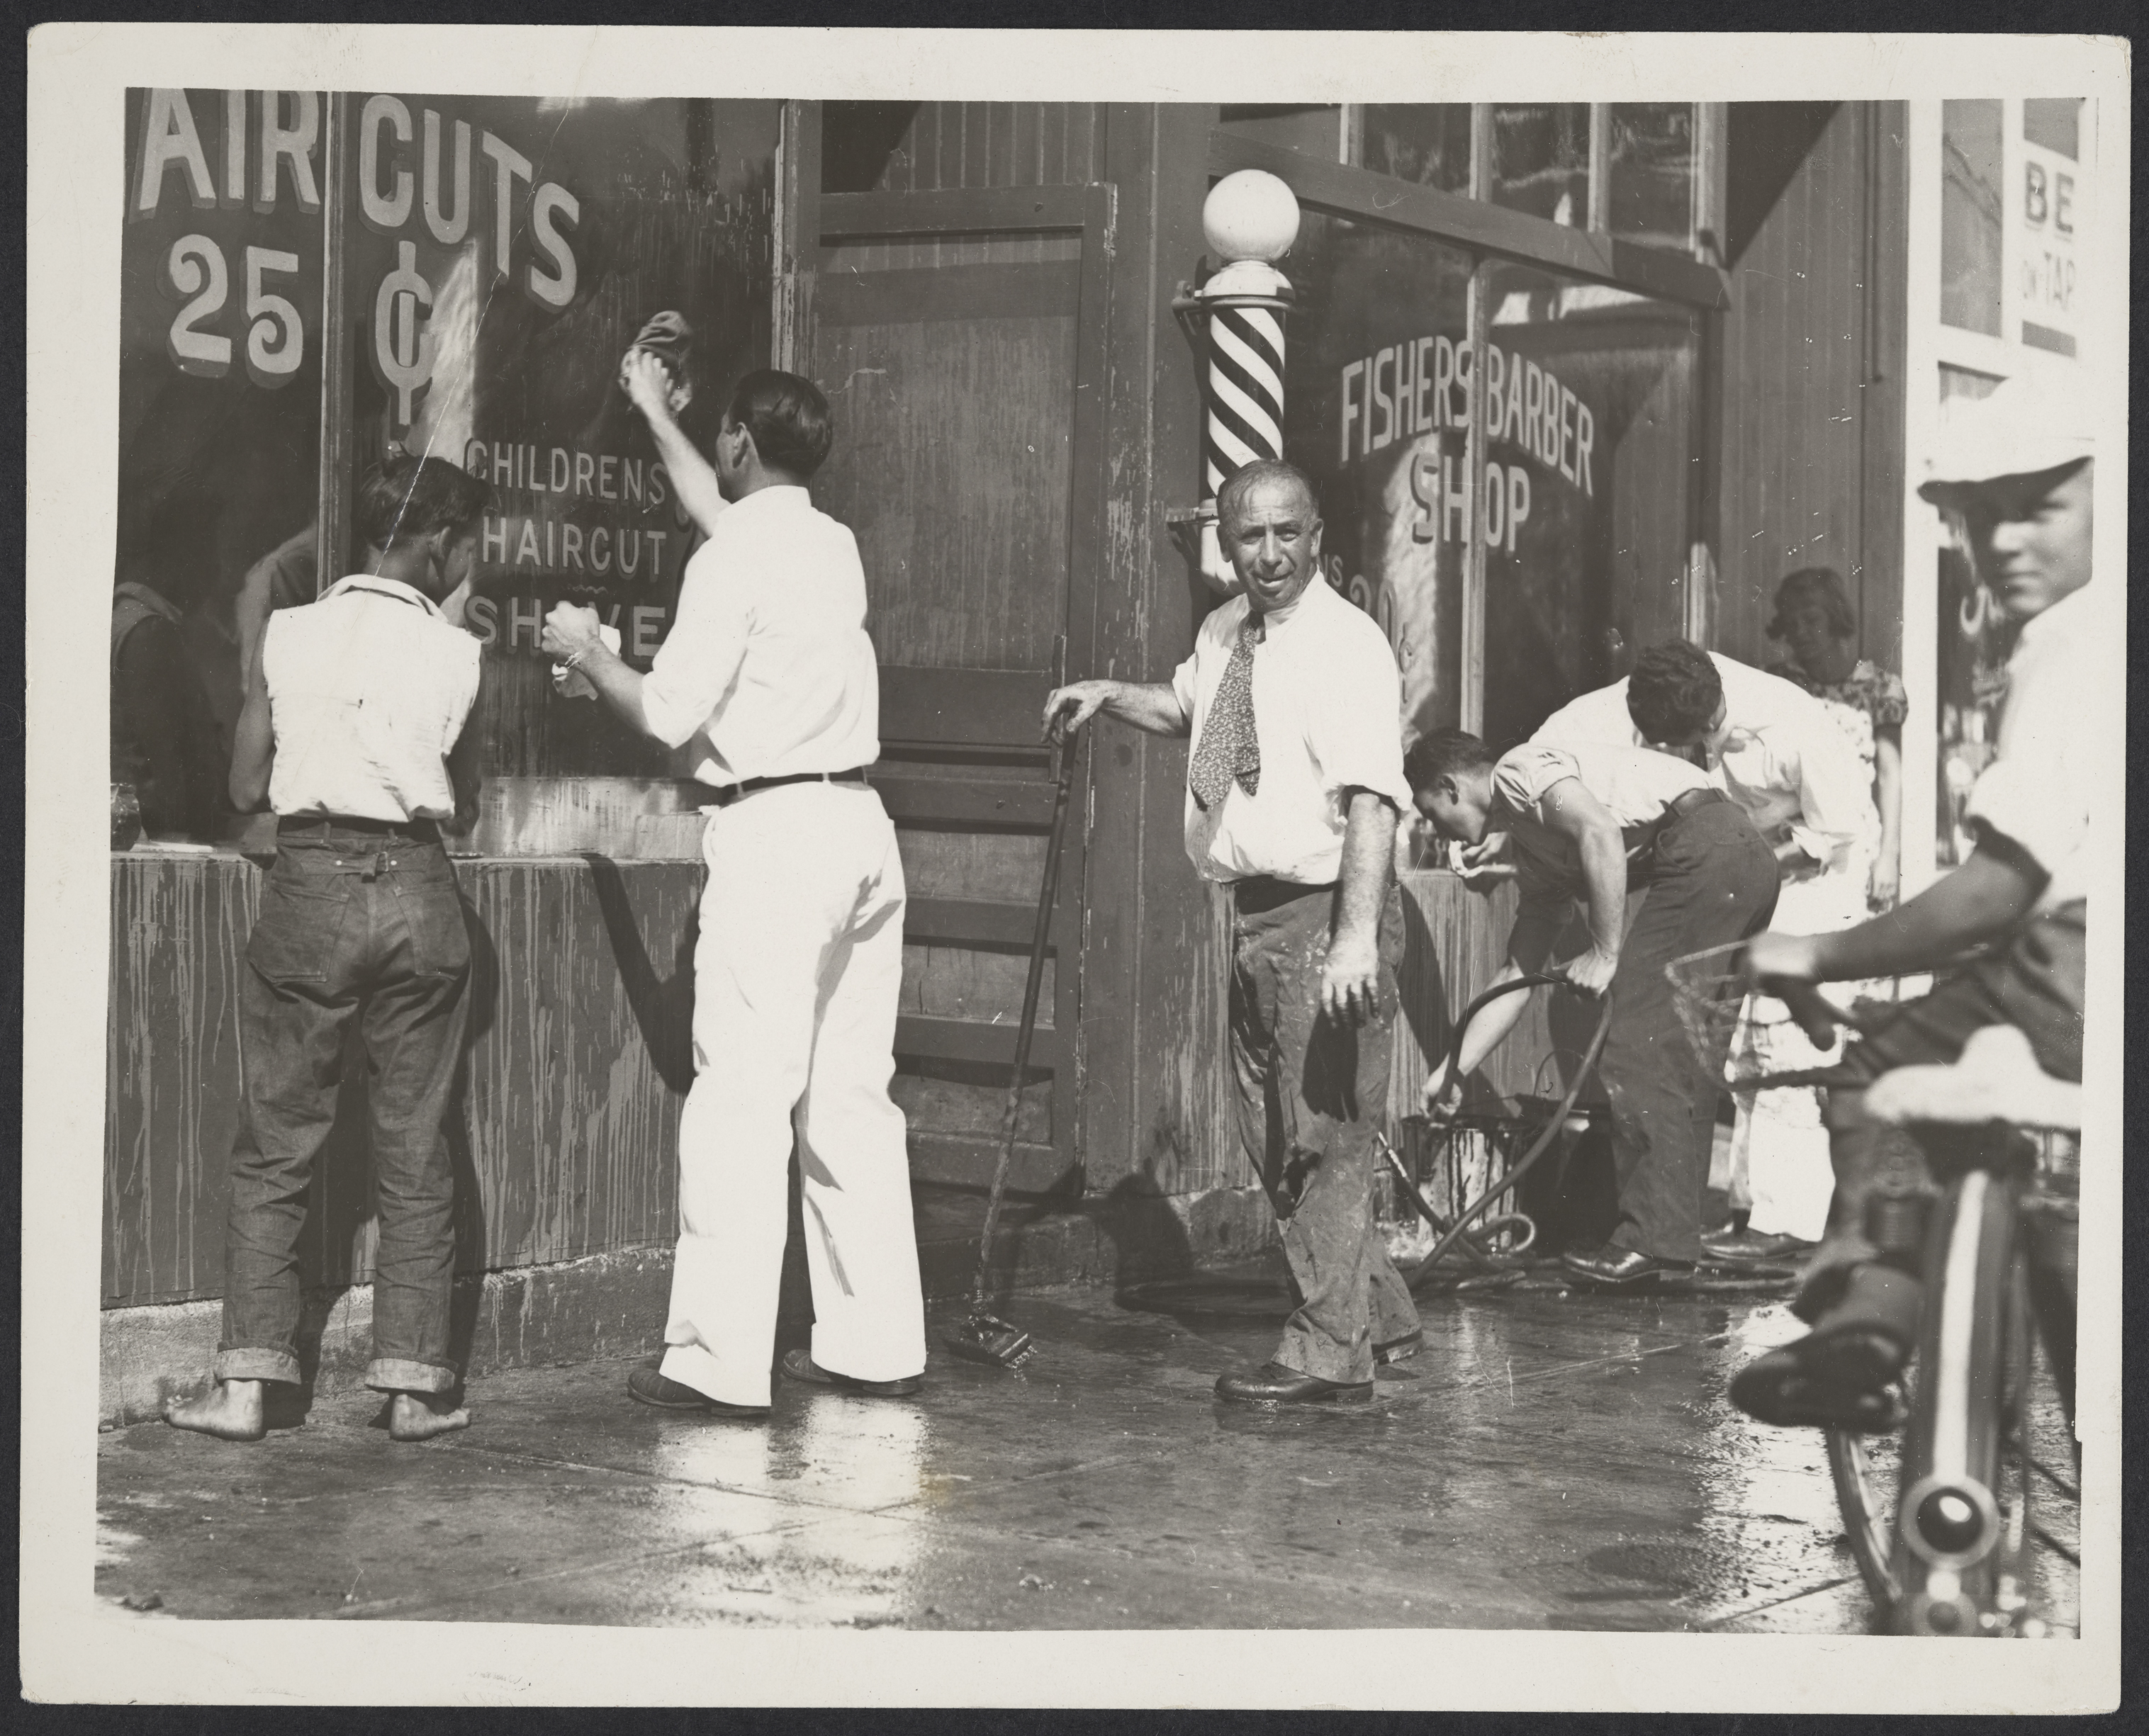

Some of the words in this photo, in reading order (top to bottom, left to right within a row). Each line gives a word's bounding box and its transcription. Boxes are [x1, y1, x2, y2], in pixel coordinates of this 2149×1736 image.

[359, 94, 580, 308] CUTS
[169, 234, 303, 376] 25
[1342, 335, 1474, 463] FISHERS
[1486, 342, 1594, 497] BARBER
[466, 440, 668, 505] CHILDRENS
[1412, 452, 1530, 552] SHOP
[483, 516, 667, 575] HAIRCUT
[465, 596, 666, 656] SHVE
